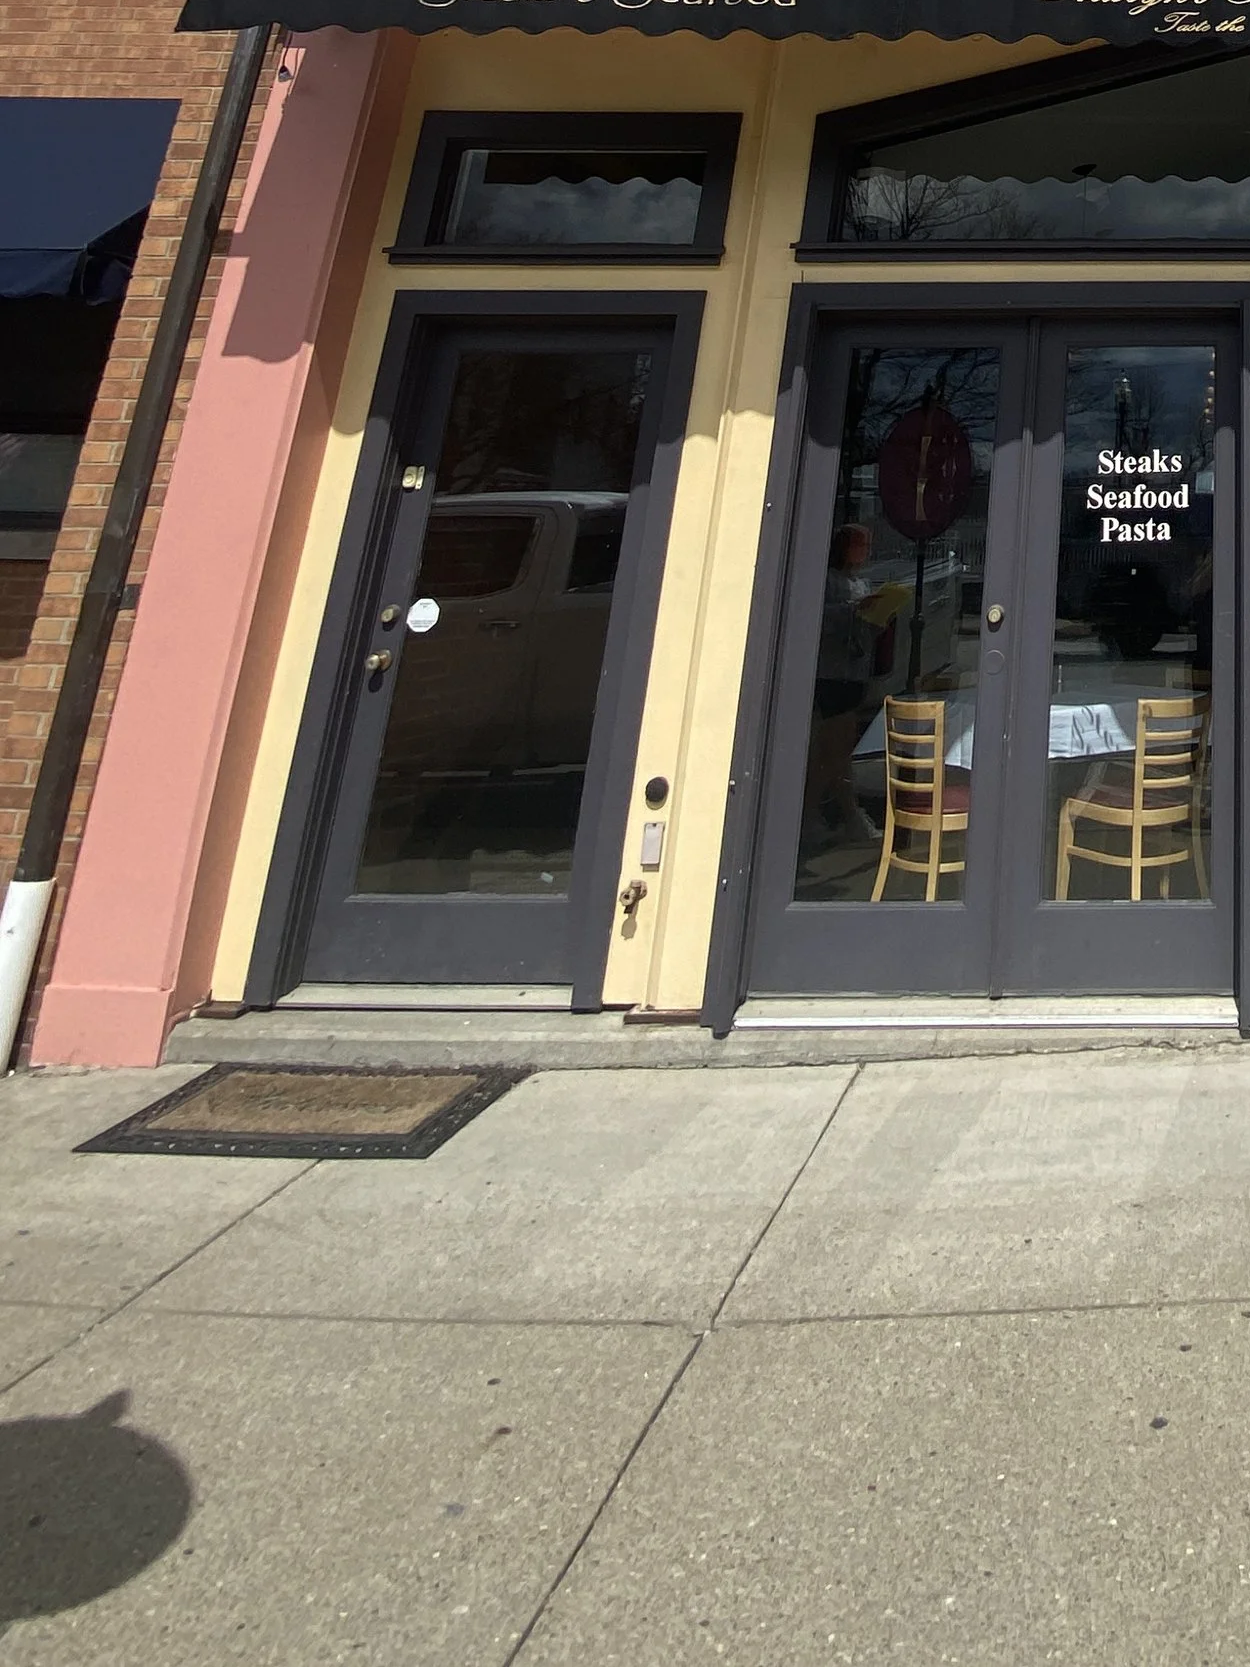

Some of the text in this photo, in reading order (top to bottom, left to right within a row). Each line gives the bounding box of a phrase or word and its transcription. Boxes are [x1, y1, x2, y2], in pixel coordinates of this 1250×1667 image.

[1153, 11, 1211, 33] Taste
[1212, 15, 1247, 33] the
[1097, 448, 1183, 475] Steaks
[1086, 483, 1190, 510] Seafood
[1100, 517, 1172, 543] Pasta
